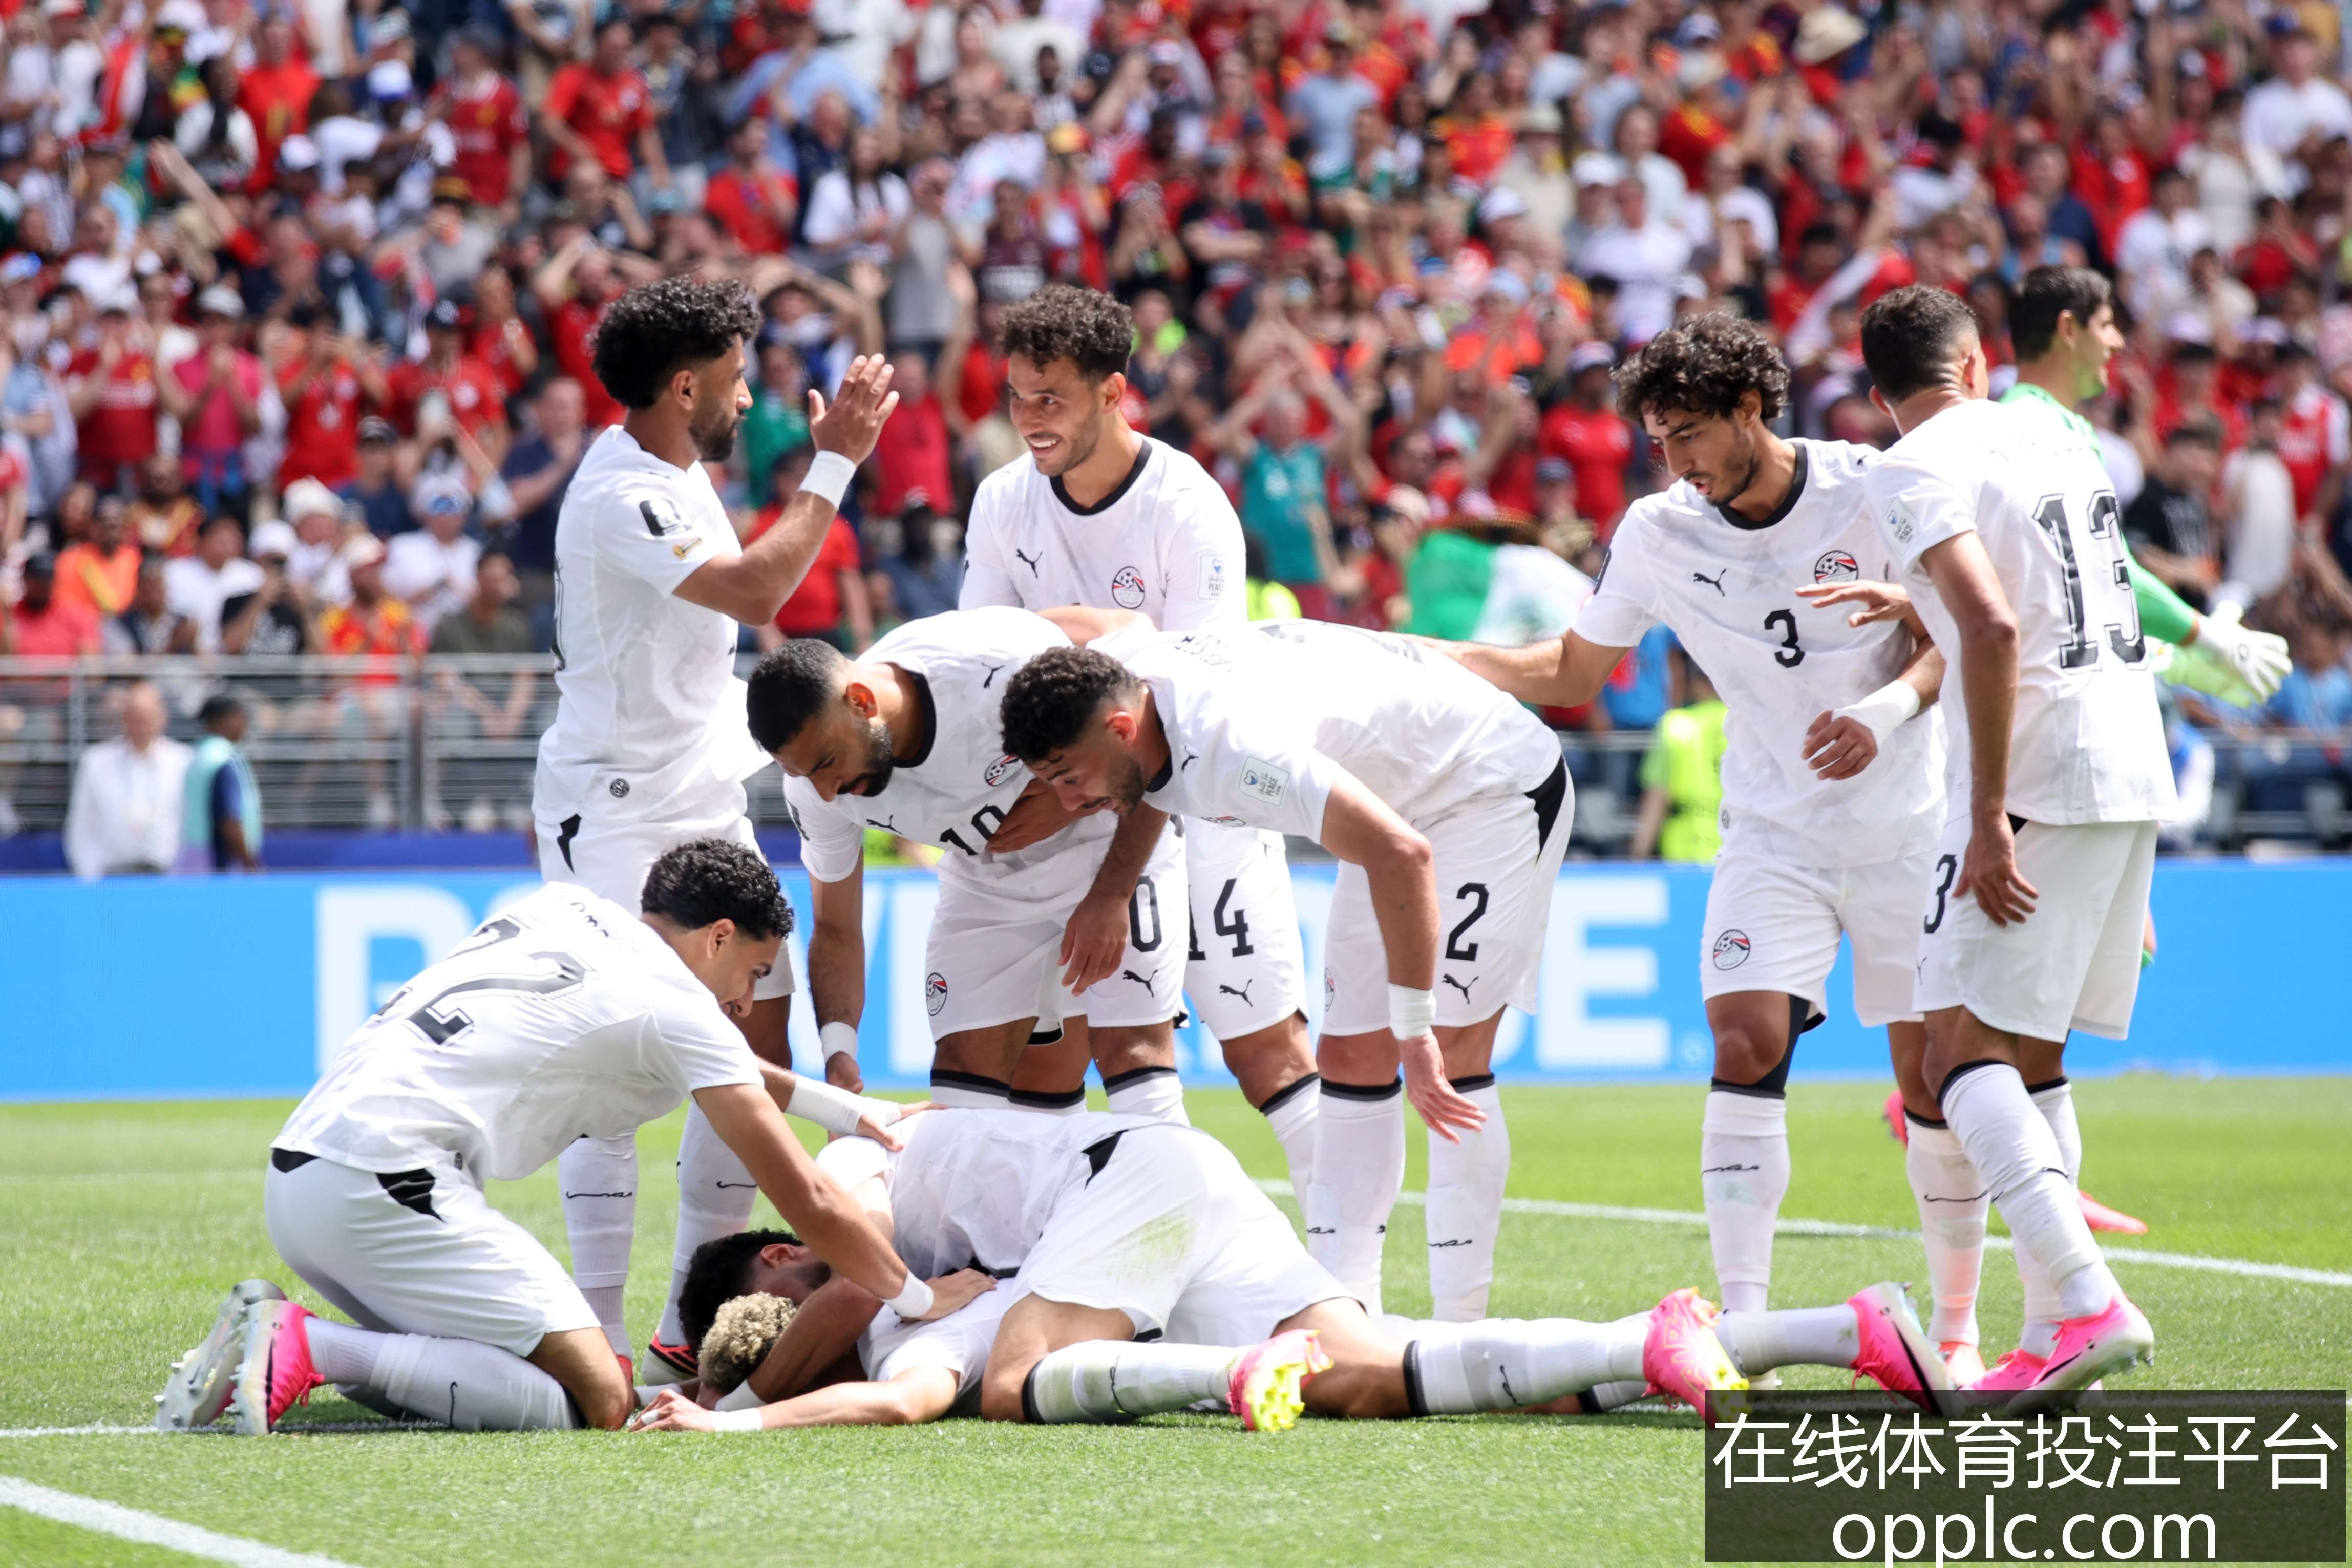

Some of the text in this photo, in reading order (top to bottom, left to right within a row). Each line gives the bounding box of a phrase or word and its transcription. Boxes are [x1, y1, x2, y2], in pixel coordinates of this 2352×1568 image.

[1209, 583, 1224, 592] PEAC
[2033, 489, 2148, 671] 13
[1764, 609, 1805, 668] 3
[1266, 777, 1278, 796] PEACE
[939, 803, 1006, 856] 10
[1129, 875, 1162, 952] 0
[1188, 878, 1255, 961] 14
[1445, 882, 1489, 961] 2
[1924, 853, 1957, 934] 3
